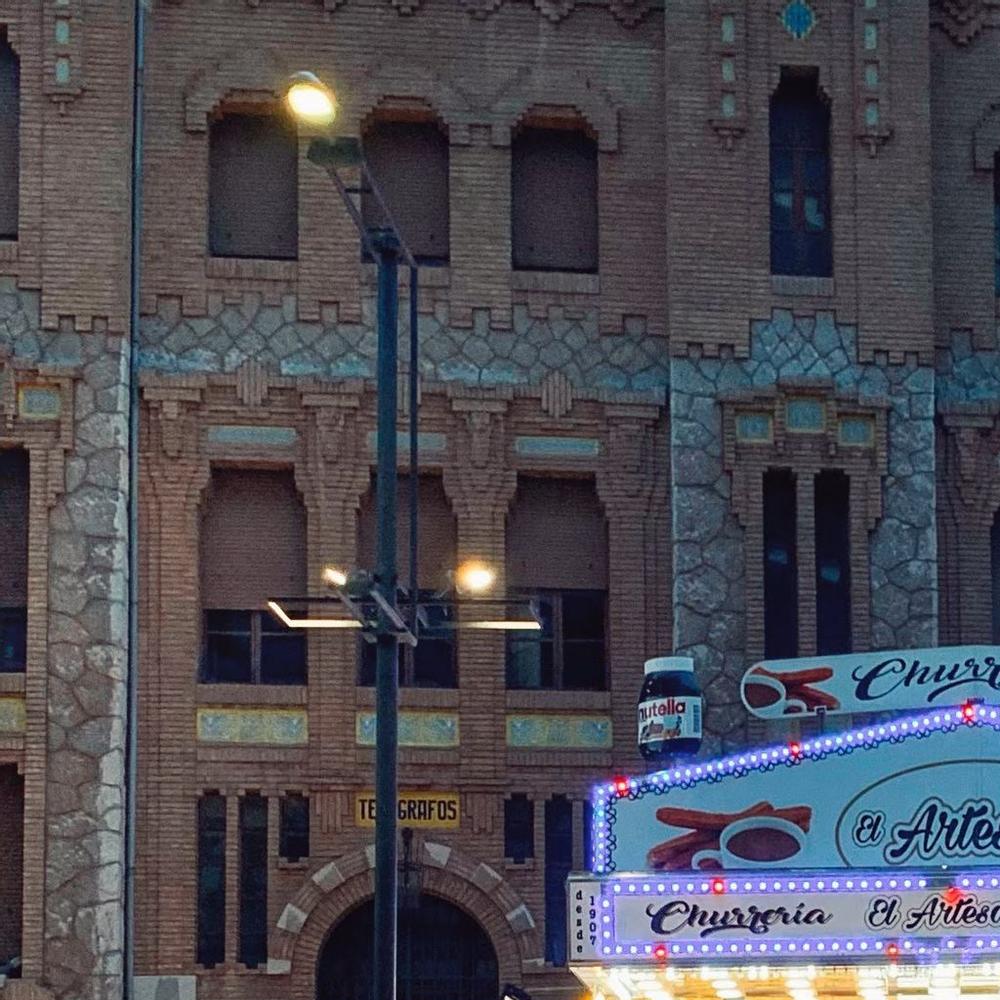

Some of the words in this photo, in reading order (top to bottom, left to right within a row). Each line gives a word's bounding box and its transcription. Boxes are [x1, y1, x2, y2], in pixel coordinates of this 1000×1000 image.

[640, 698, 686, 720] nutella
[359, 799, 457, 820] TEGRAFOS
[854, 812, 884, 845] El
[575, 889, 583, 953] desde
[589, 895, 597, 946] 1907
[646, 900, 834, 938] Churrería
[867, 898, 898, 928] El
